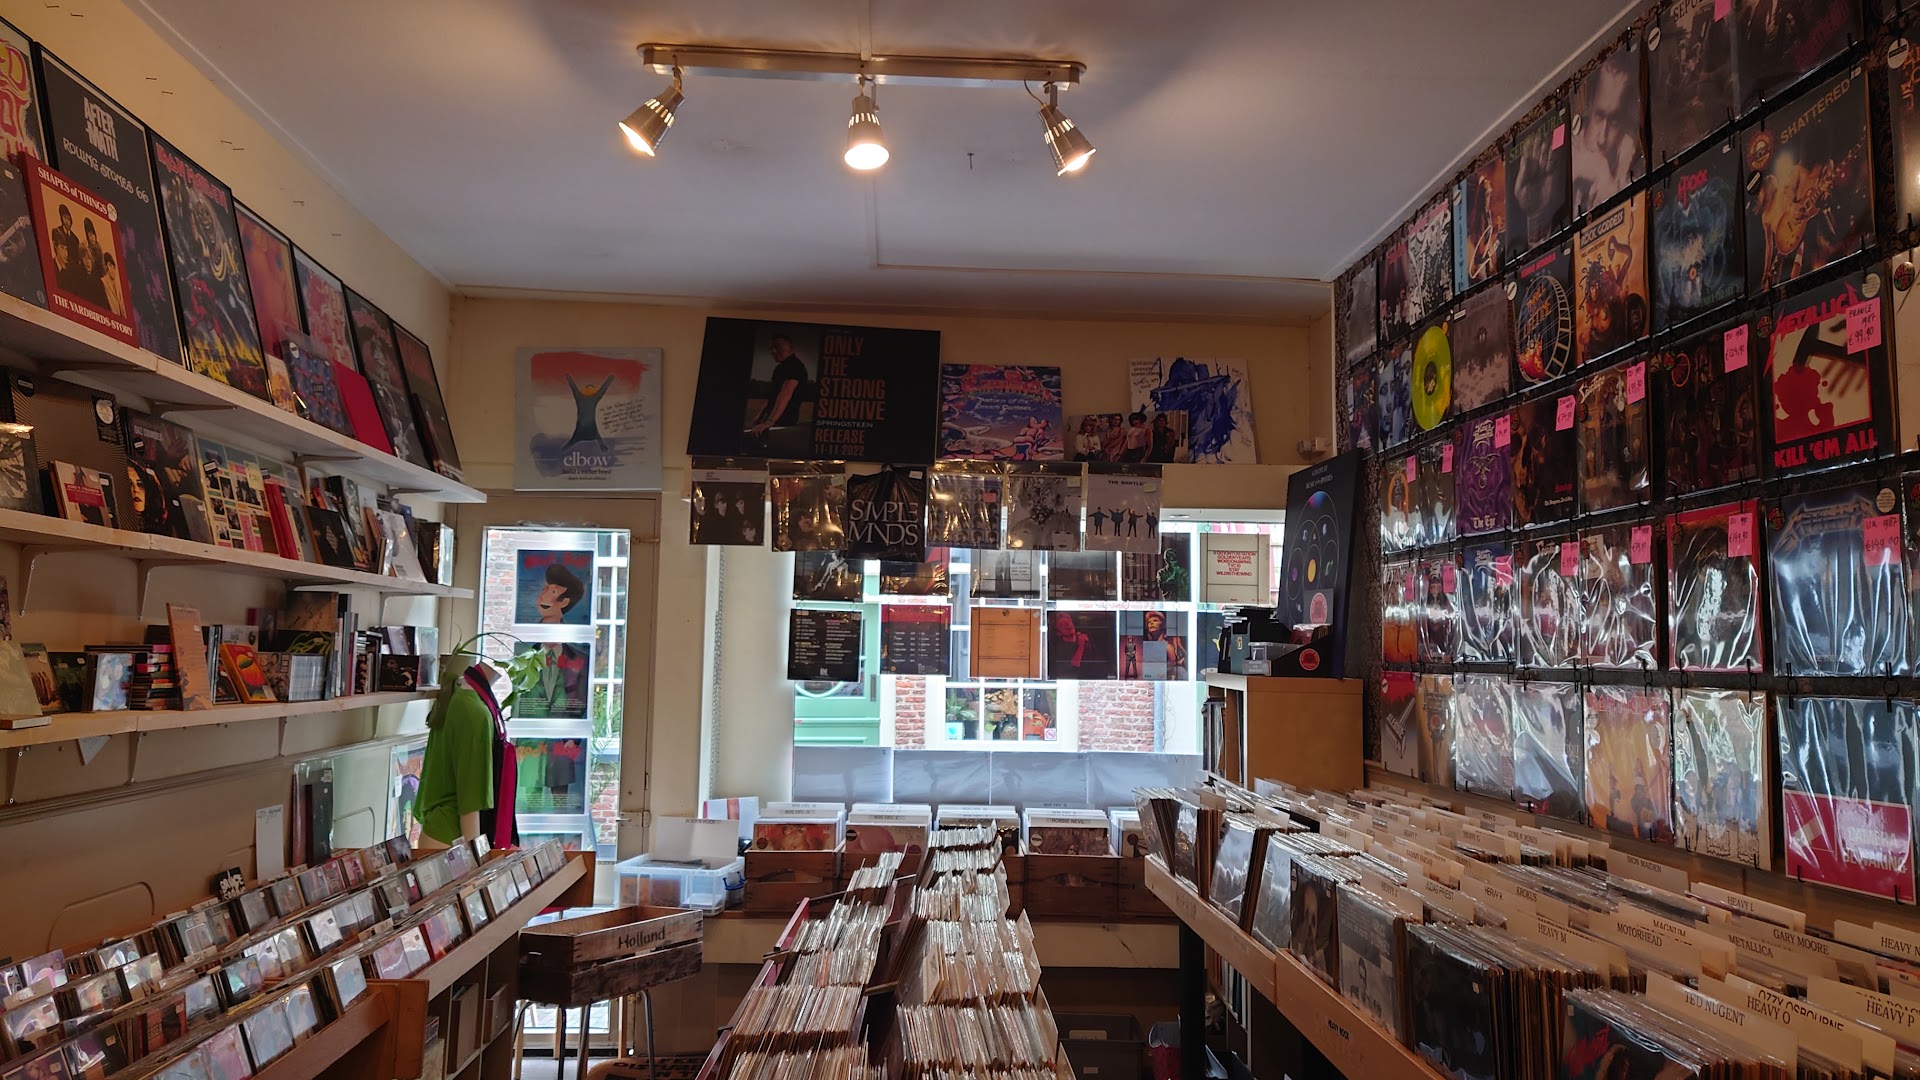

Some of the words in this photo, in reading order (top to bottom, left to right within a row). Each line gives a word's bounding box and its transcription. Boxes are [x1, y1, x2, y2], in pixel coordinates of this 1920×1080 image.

[1780, 78, 1850, 144] SHATTERED
[37, 167, 70, 194] SHAPES
[70, 187, 78, 198] of
[77, 189, 107, 215] THINGS
[1580, 228, 1597, 248] ROCK
[1597, 212, 1624, 237] GODDESS
[53, 293, 69, 311] THE
[824, 335, 864, 356] ONLY
[823, 356, 848, 376] THE
[820, 377, 886, 399] STRONG
[818, 398, 885, 420] SURVIVE
[816, 420, 873, 428] SPRINGSTEEN
[816, 428, 865, 443] RELEASE
[563, 451, 611, 467] elbow
[1774, 443, 1807, 468] KILL
[1845, 428, 1878, 453] ALL
[1627, 855, 1640, 866] IRON
[1640, 860, 1662, 873] MAIDEN
[1439, 886, 1454, 900] PRIEST
[1516, 886, 1538, 902] KROKUS
[1727, 896, 1749, 910] HEAVY
[1750, 904, 1755, 912] L
[619, 926, 665, 949] Holland
[1538, 923, 1559, 941] HEAVY
[1559, 932, 1567, 943] M
[1617, 922, 1662, 947] MOTORHEAD
[1773, 929, 1795, 944] GARY
[1797, 937, 1829, 956] MOORE
[1729, 934, 1773, 958] METALLICA
[1881, 936, 1912, 954] HEAVY
[1684, 991, 1701, 1006] TED
[1704, 1001, 1745, 1027] NUGENT
[1747, 996, 1780, 1020] HEAVY
[1783, 1010, 1791, 1025] O
[1867, 999, 1904, 1024] HEAVY
[1908, 1014, 1915, 1028] P
